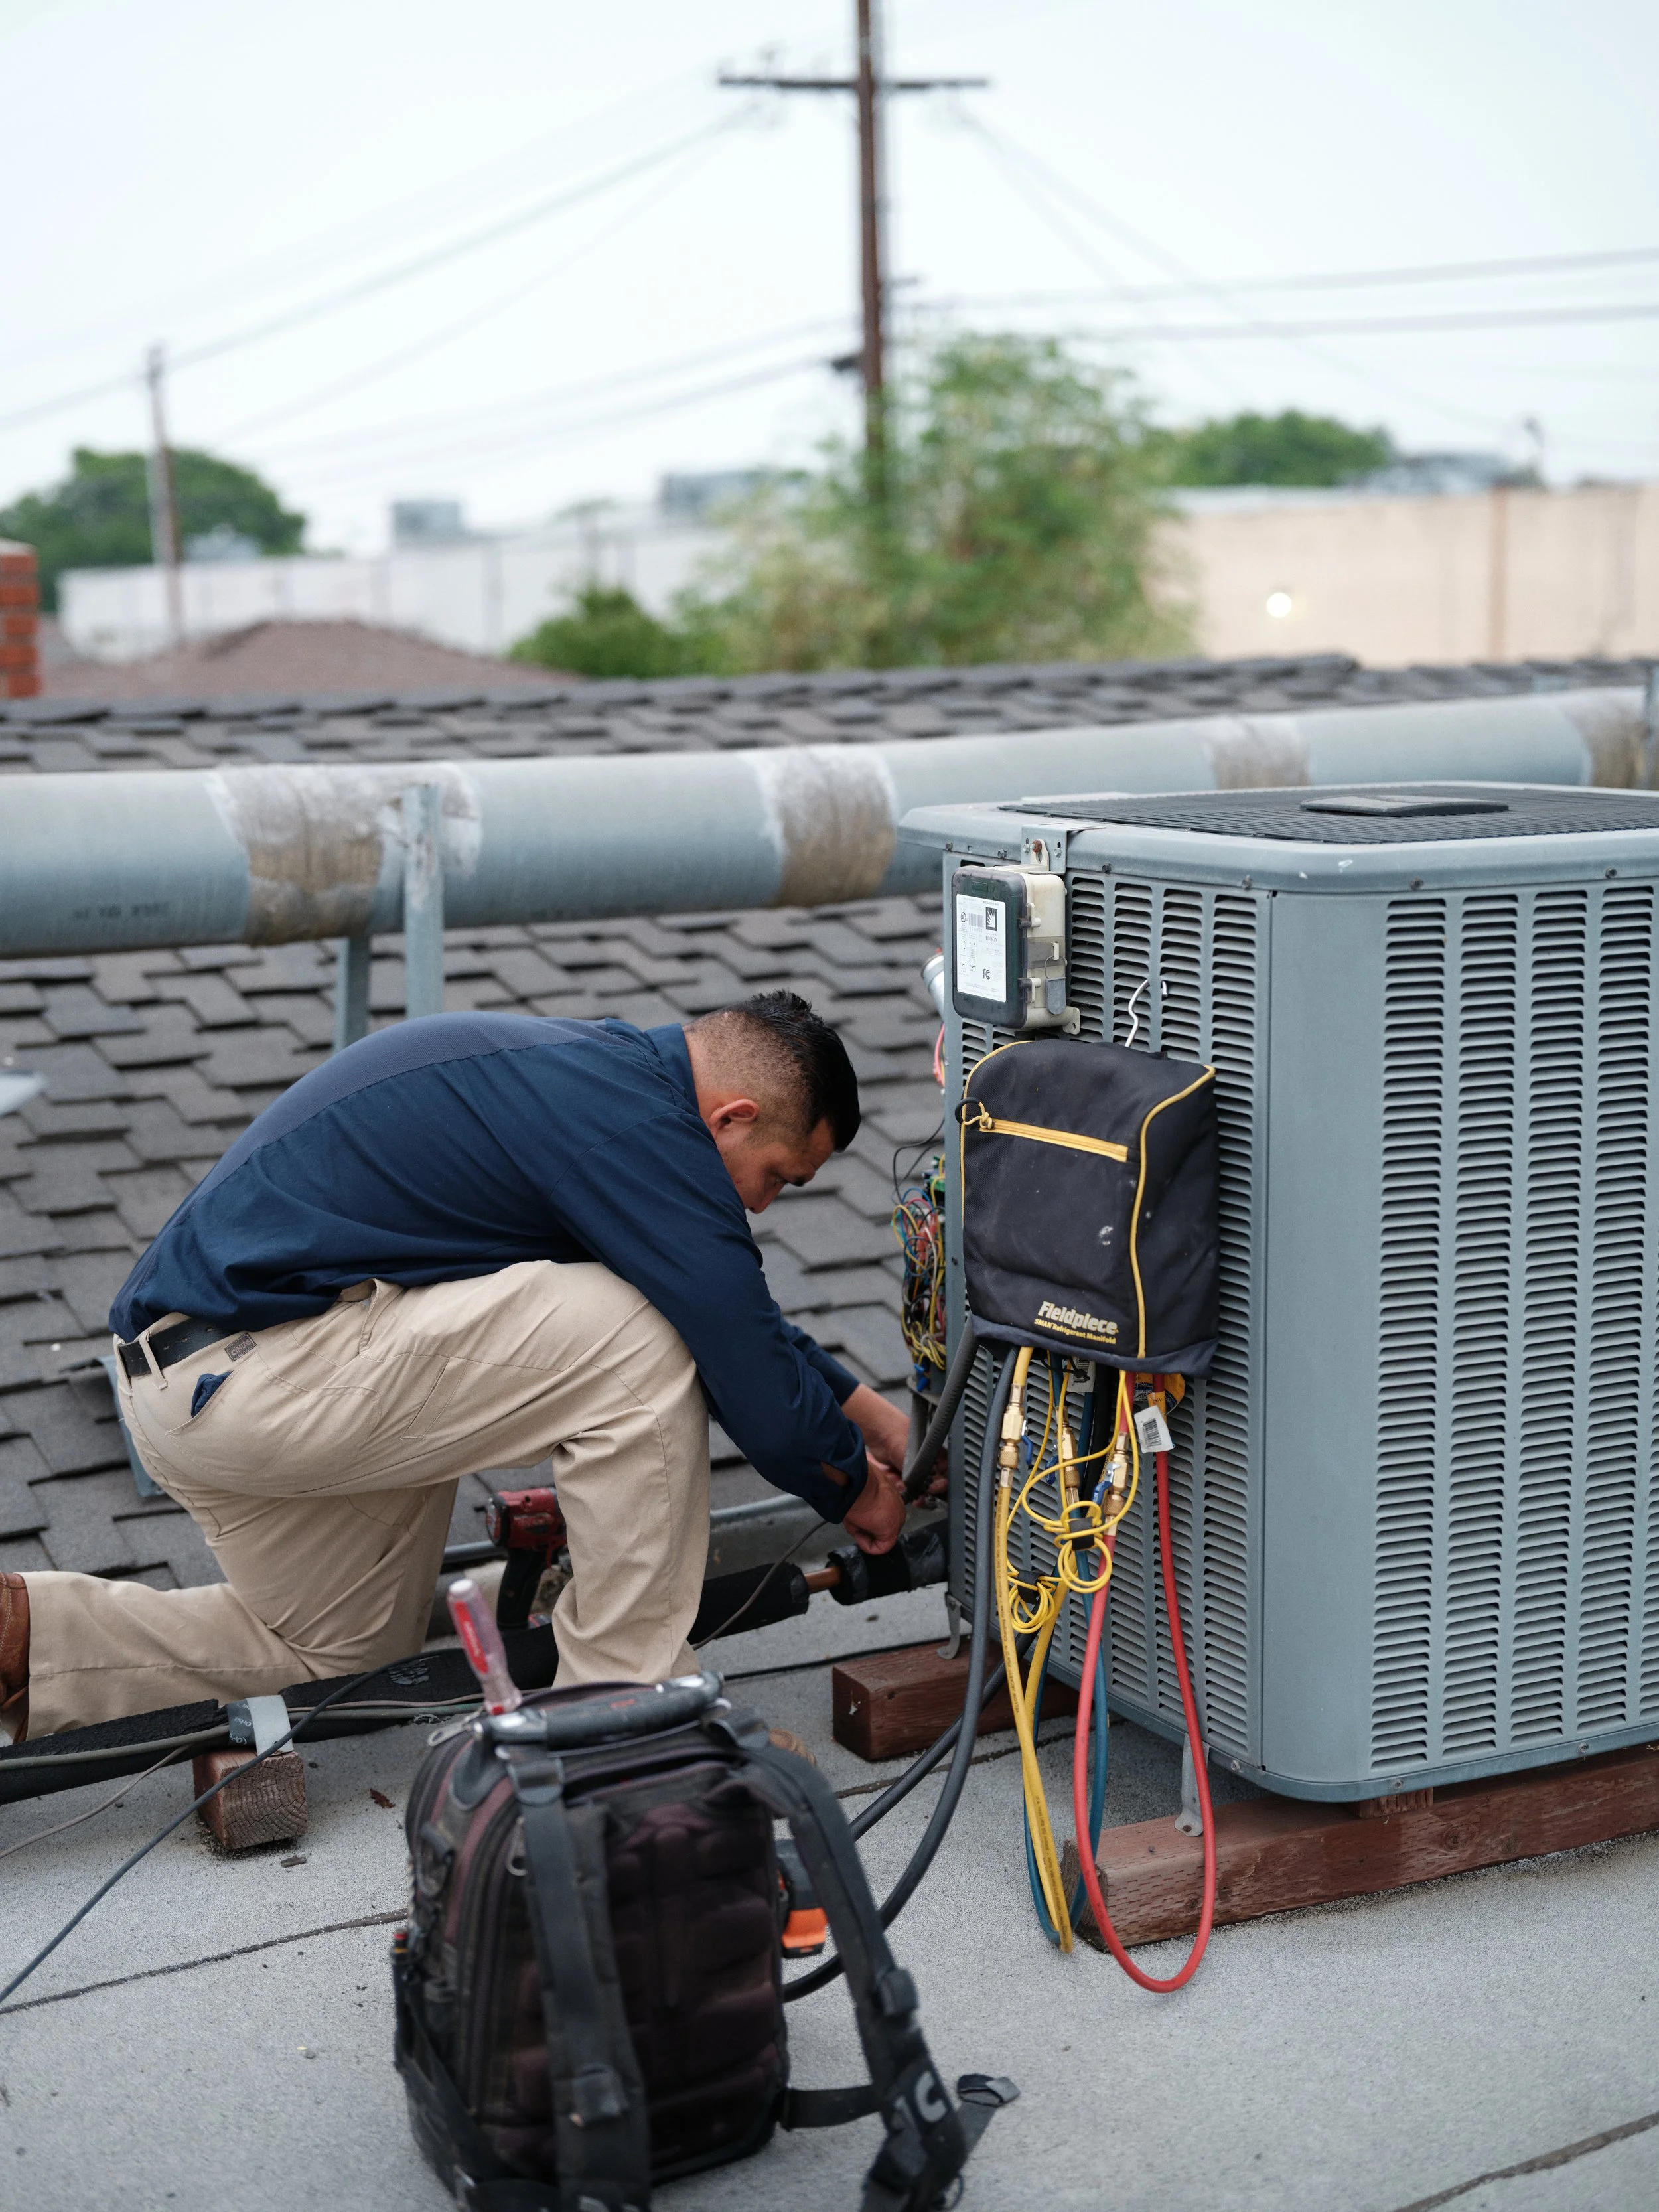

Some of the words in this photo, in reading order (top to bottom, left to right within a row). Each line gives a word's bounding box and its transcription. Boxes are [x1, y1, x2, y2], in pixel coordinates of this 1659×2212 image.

[1038, 1301, 1118, 1335] Fieldpiece
[1052, 1323, 1086, 1338] Refrigerant
[1087, 1333, 1116, 1344] Manifold
